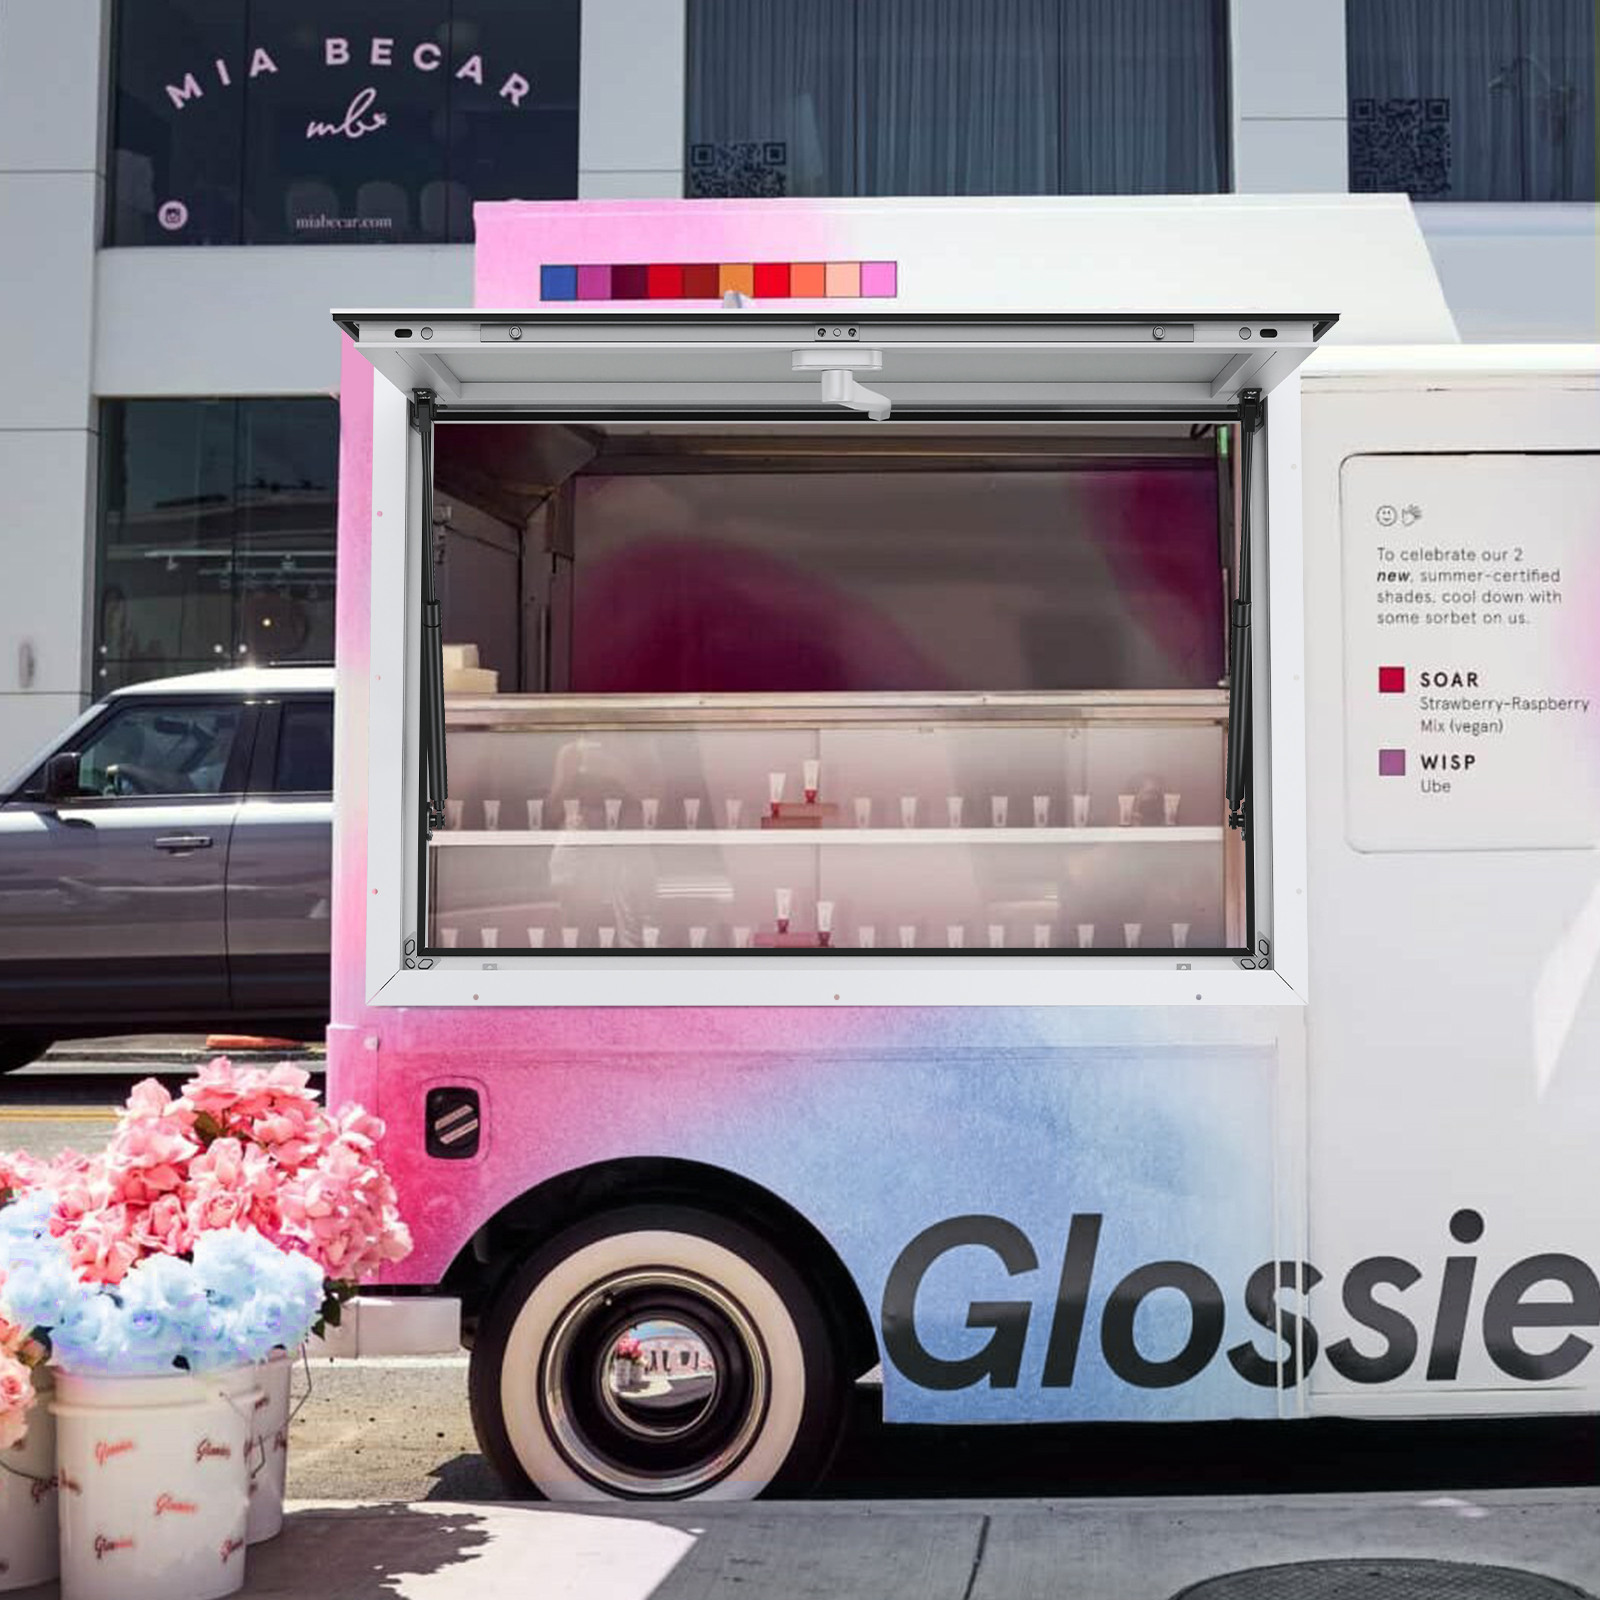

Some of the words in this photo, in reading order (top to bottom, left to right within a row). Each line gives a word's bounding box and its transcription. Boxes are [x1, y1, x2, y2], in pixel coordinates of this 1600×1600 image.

[165, 47, 278, 109] MIA
[325, 38, 531, 107] BECAR
[295, 213, 393, 229] miabecar.com
[1376, 546, 1395, 562] To
[1399, 546, 1477, 562] celebrate
[1481, 550, 1509, 562] our
[1513, 547, 1524, 562] 2
[1420, 568, 1561, 583] summer-certified
[1441, 589, 1477, 604] cool
[1481, 589, 1525, 604] down
[1528, 589, 1563, 604] with
[1376, 612, 1420, 625] some
[1425, 609, 1477, 625] sorbet
[1482, 613, 1502, 625] on
[1419, 671, 1480, 688] SOAR
[1419, 696, 1591, 713] Strawberry-Raspberry
[1420, 719, 1446, 733] Mix
[1449, 718, 1504, 737] (vegan)
[1419, 753, 1477, 771] WISP
[1420, 778, 1452, 794] Ube
[880, 1208, 1600, 1391] Glossie
